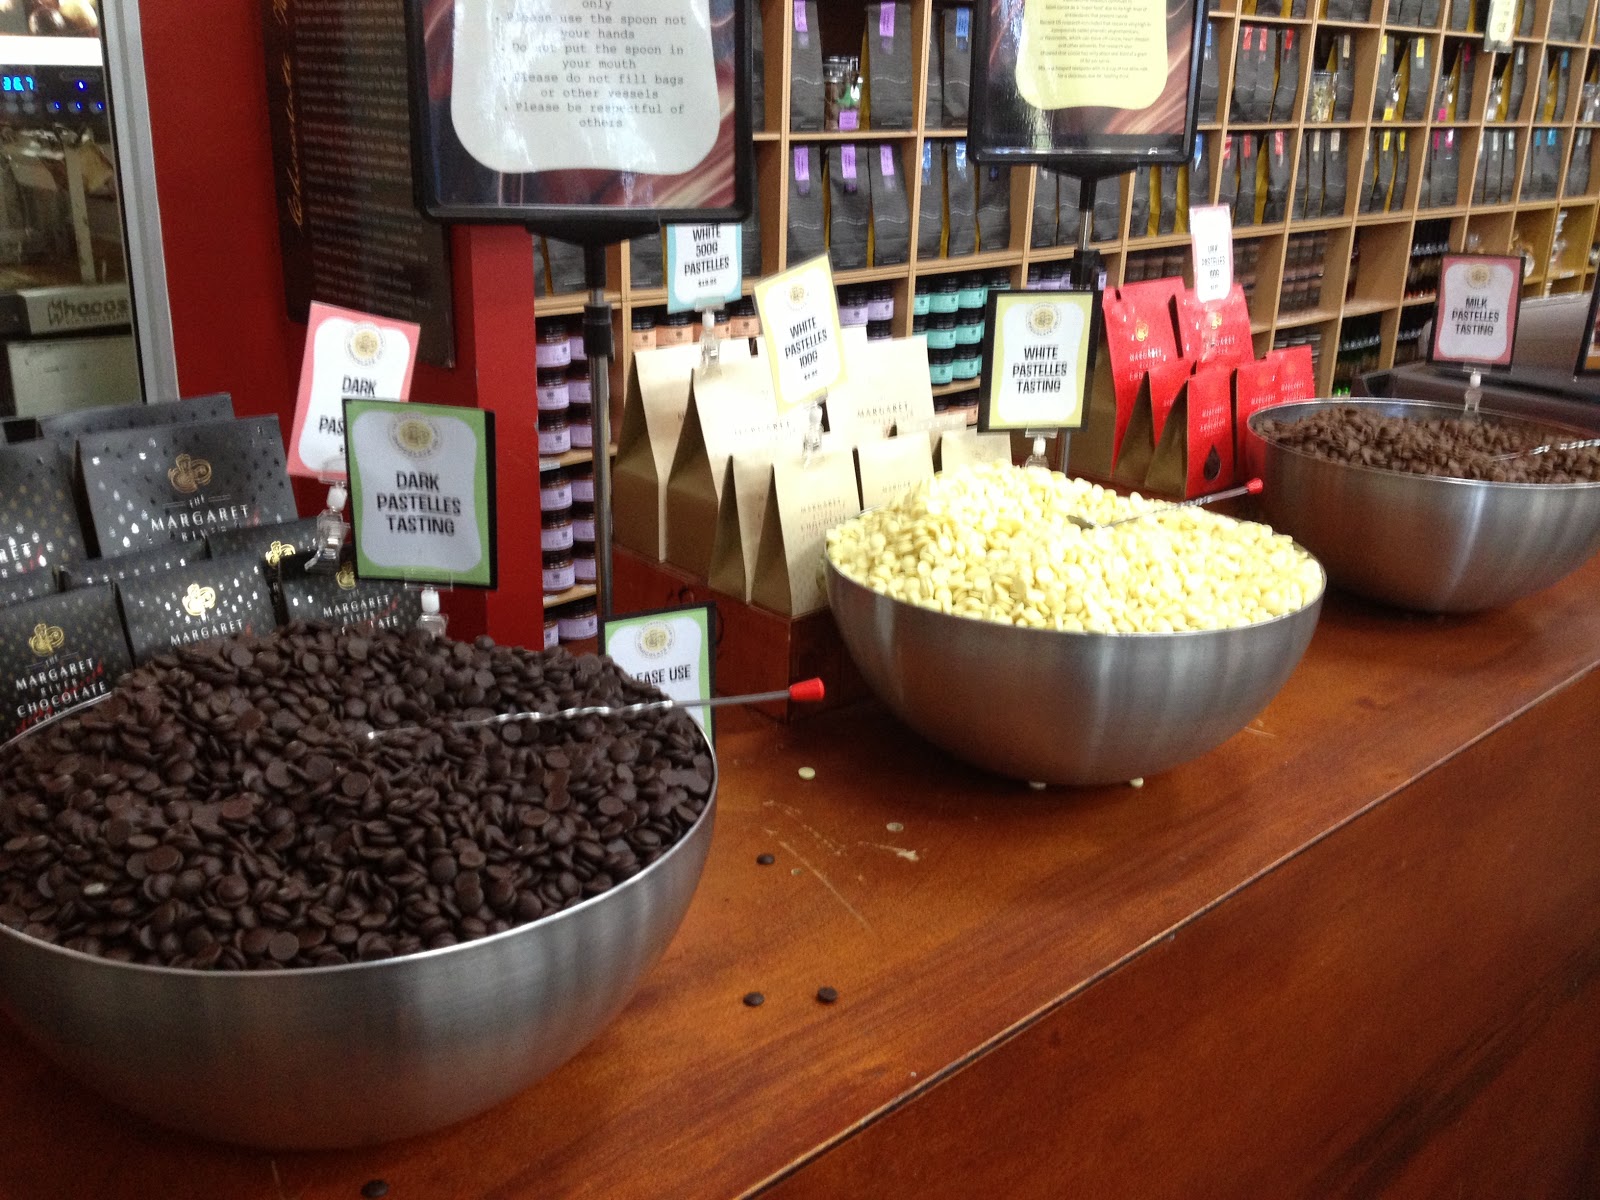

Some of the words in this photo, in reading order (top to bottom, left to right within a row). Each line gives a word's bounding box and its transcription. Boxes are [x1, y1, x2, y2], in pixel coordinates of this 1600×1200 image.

[560, 15, 582, 24] use
[590, 14, 612, 24] the
[620, 15, 657, 26] spoon
[664, 16, 687, 25] not
[560, 30, 590, 40] your
[598, 29, 635, 39] hands
[565, 45, 586, 56] put
[595, 45, 617, 54] the
[625, 46, 662, 56] spoon
[671, 46, 684, 55] in
[563, 60, 590, 70] your
[598, 60, 636, 69] mouth
[514, 73, 559, 83] Please
[566, 73, 581, 83] do
[588, 75, 610, 83] not
[619, 74, 647, 84] fill
[655, 74, 684, 87] bags
[541, 89, 554, 98] or
[563, 89, 598, 98] other
[608, 89, 659, 99] vessels
[515, 103, 560, 113] Please
[567, 103, 582, 112] be
[590, 103, 663, 114] respectful
[670, 104, 685, 113] of
[579, 117, 623, 127] others
[692, 224, 721, 241] WHITE
[696, 242, 718, 257] 500G
[684, 256, 729, 276] PASTELLES
[1465, 296, 1488, 309] MILK
[1451, 308, 1500, 323] PASTELLES
[789, 316, 817, 339] WHITE
[1455, 323, 1494, 336] TASTING
[784, 328, 828, 359] PASTELLES
[1024, 344, 1058, 360] WHITE
[799, 350, 818, 369] 100G
[1012, 361, 1067, 378] PASTELLES
[342, 374, 377, 398] DARK
[1017, 378, 1061, 394] TASTING
[396, 470, 439, 491] DARK
[377, 492, 461, 517] PASTELLES
[151, 504, 249, 532] MARGARET
[386, 514, 455, 537] TASTING
[323, 594, 389, 618] MARGARET
[170, 619, 243, 646] MARGARET
[16, 658, 93, 691] MARGARET
[630, 668, 666, 684] EASE
[669, 664, 691, 682] USE
[40, 679, 78, 697] RIVER
[17, 681, 107, 718] CHOCOLATE
